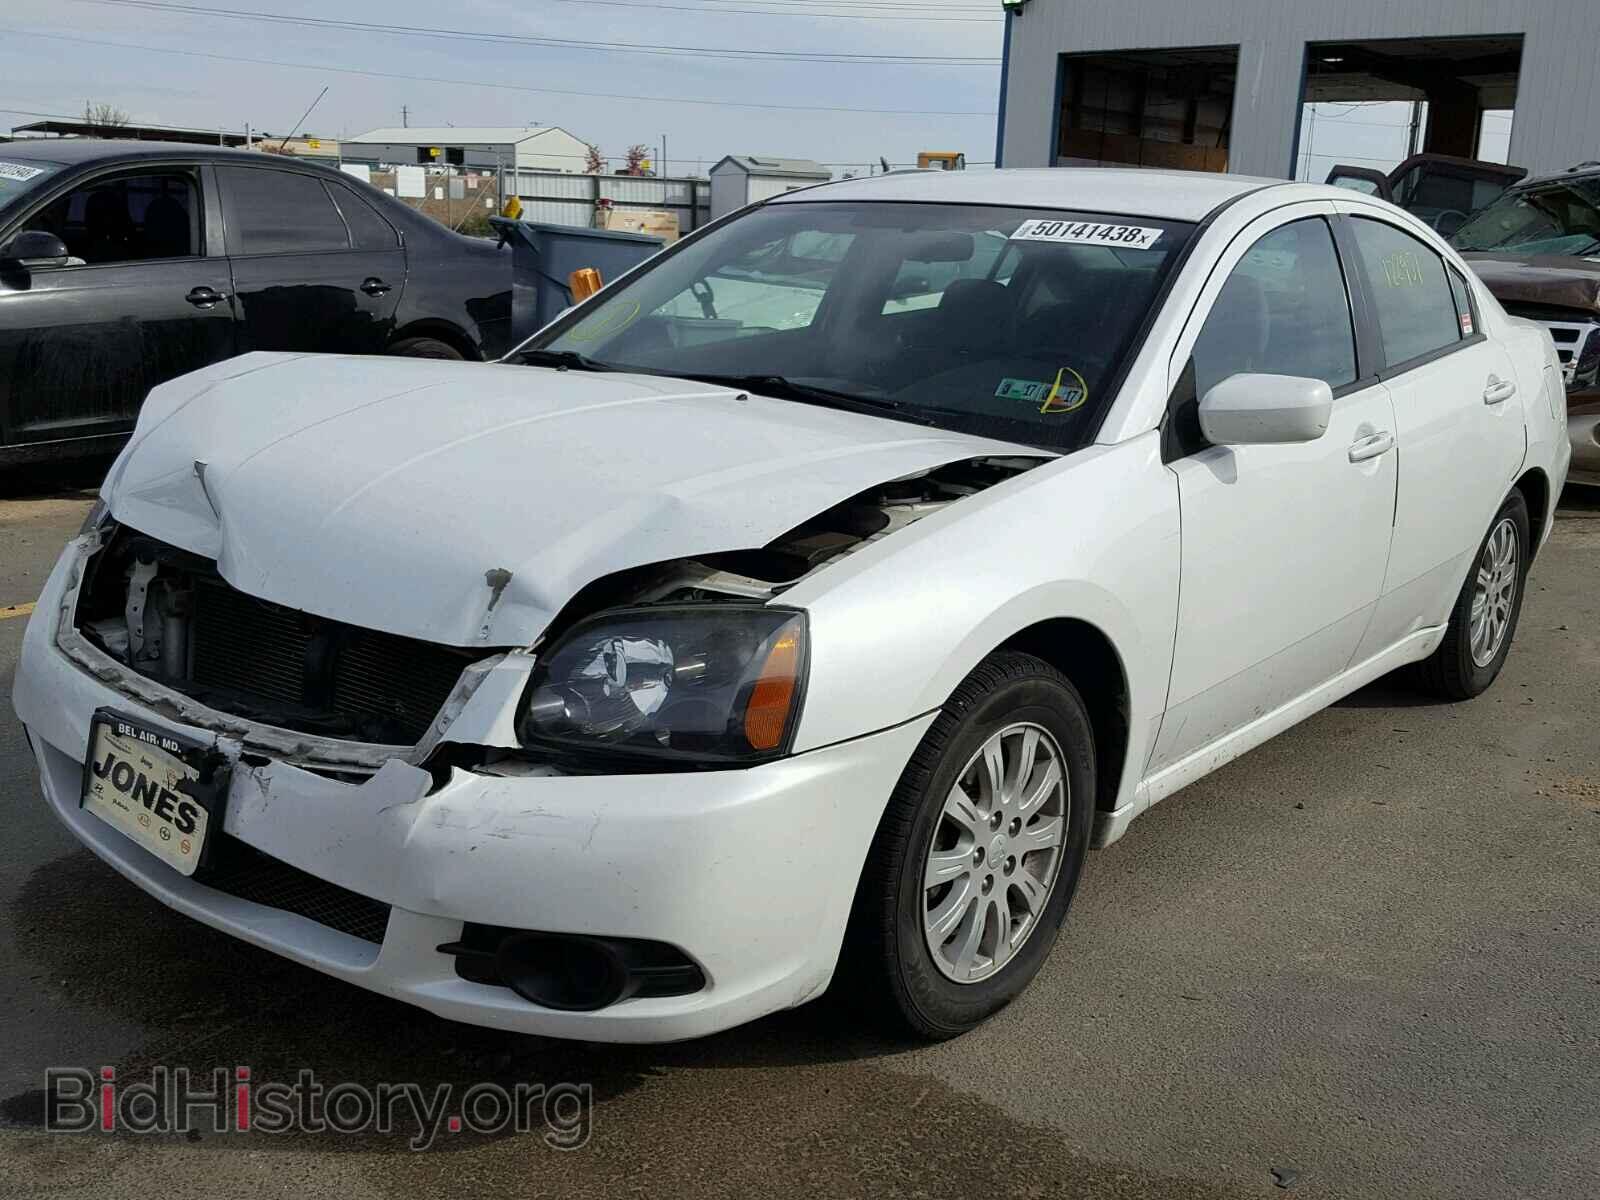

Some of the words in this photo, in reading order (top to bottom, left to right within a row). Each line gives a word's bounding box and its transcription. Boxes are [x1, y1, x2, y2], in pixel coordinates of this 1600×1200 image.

[118, 723, 137, 738] BEL
[162, 738, 181, 752] MD.
[93, 752, 199, 834] JONES
